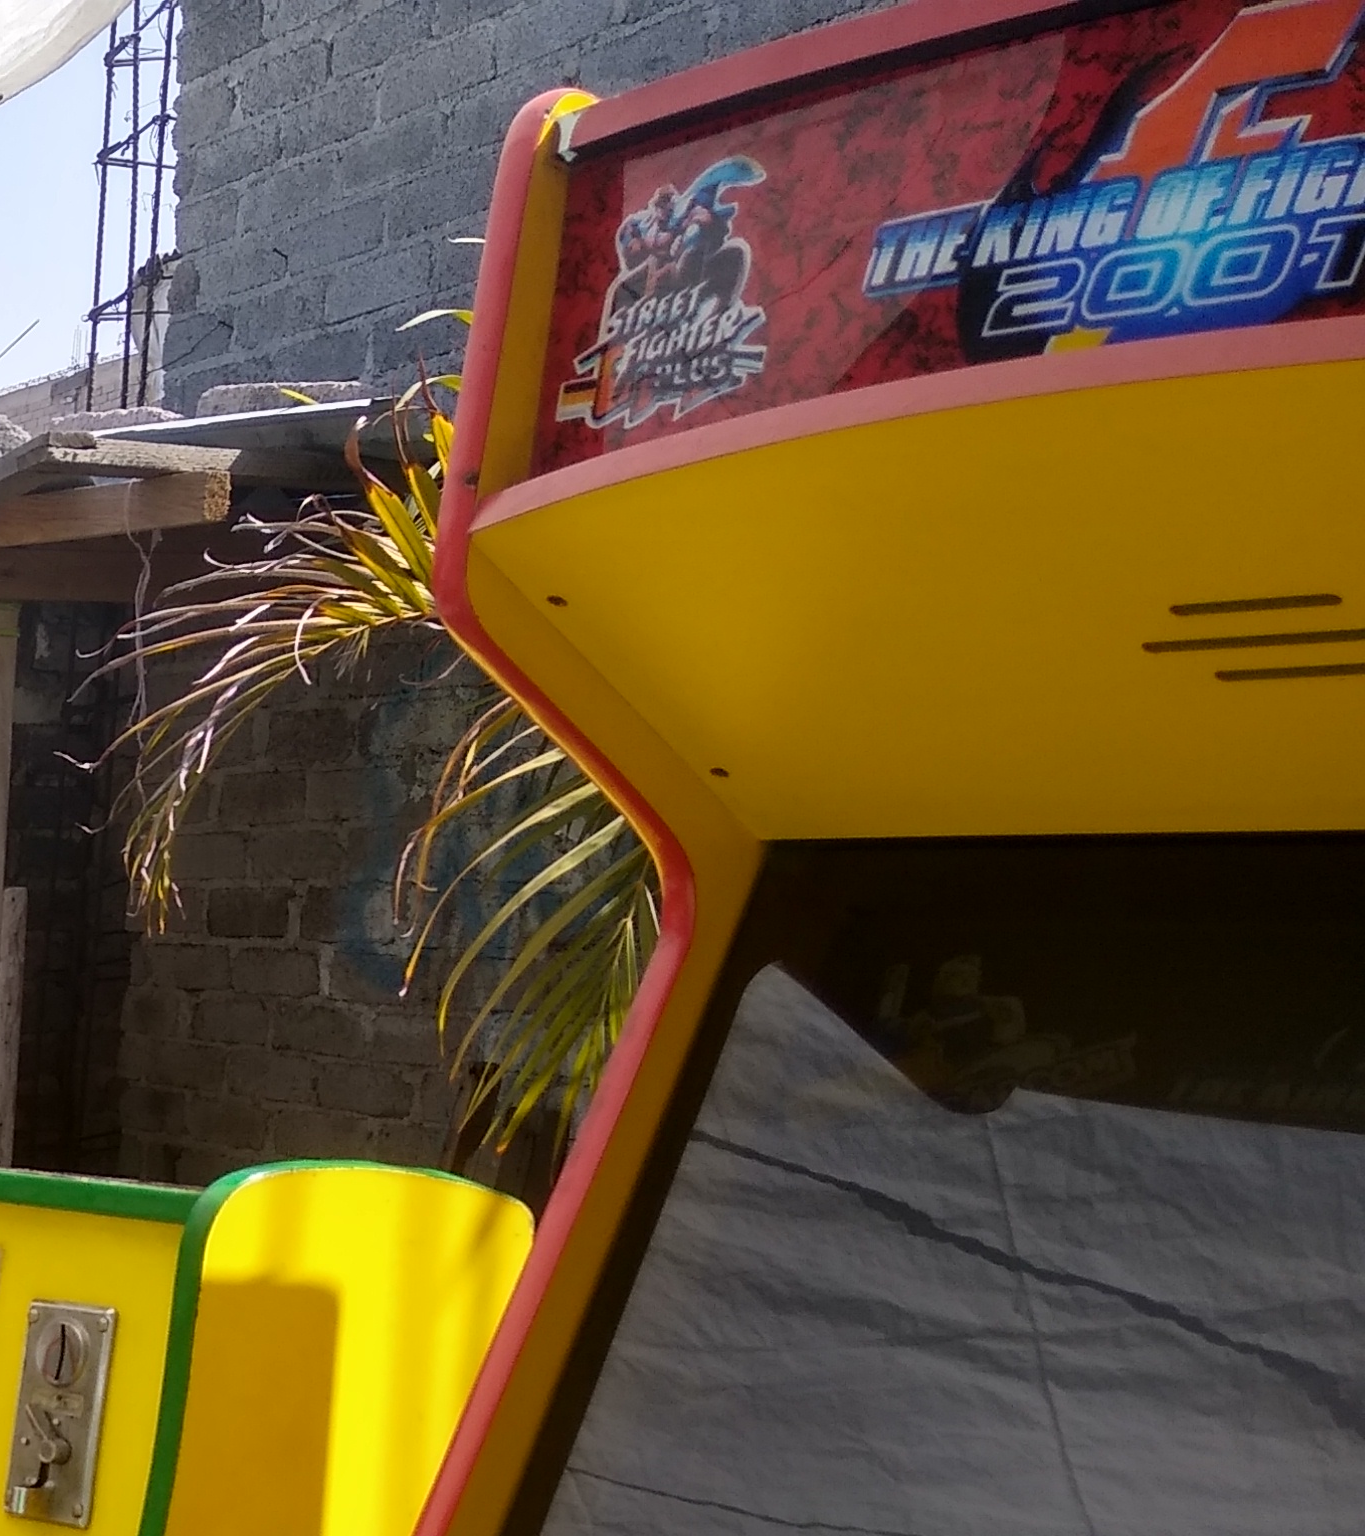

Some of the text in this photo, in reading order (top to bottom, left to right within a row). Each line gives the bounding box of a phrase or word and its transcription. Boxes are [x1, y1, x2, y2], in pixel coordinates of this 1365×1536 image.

[871, 215, 969, 288] THE
[971, 180, 1139, 268] KING
[607, 280, 710, 335] STREET
[616, 307, 746, 374] FIGHTER
